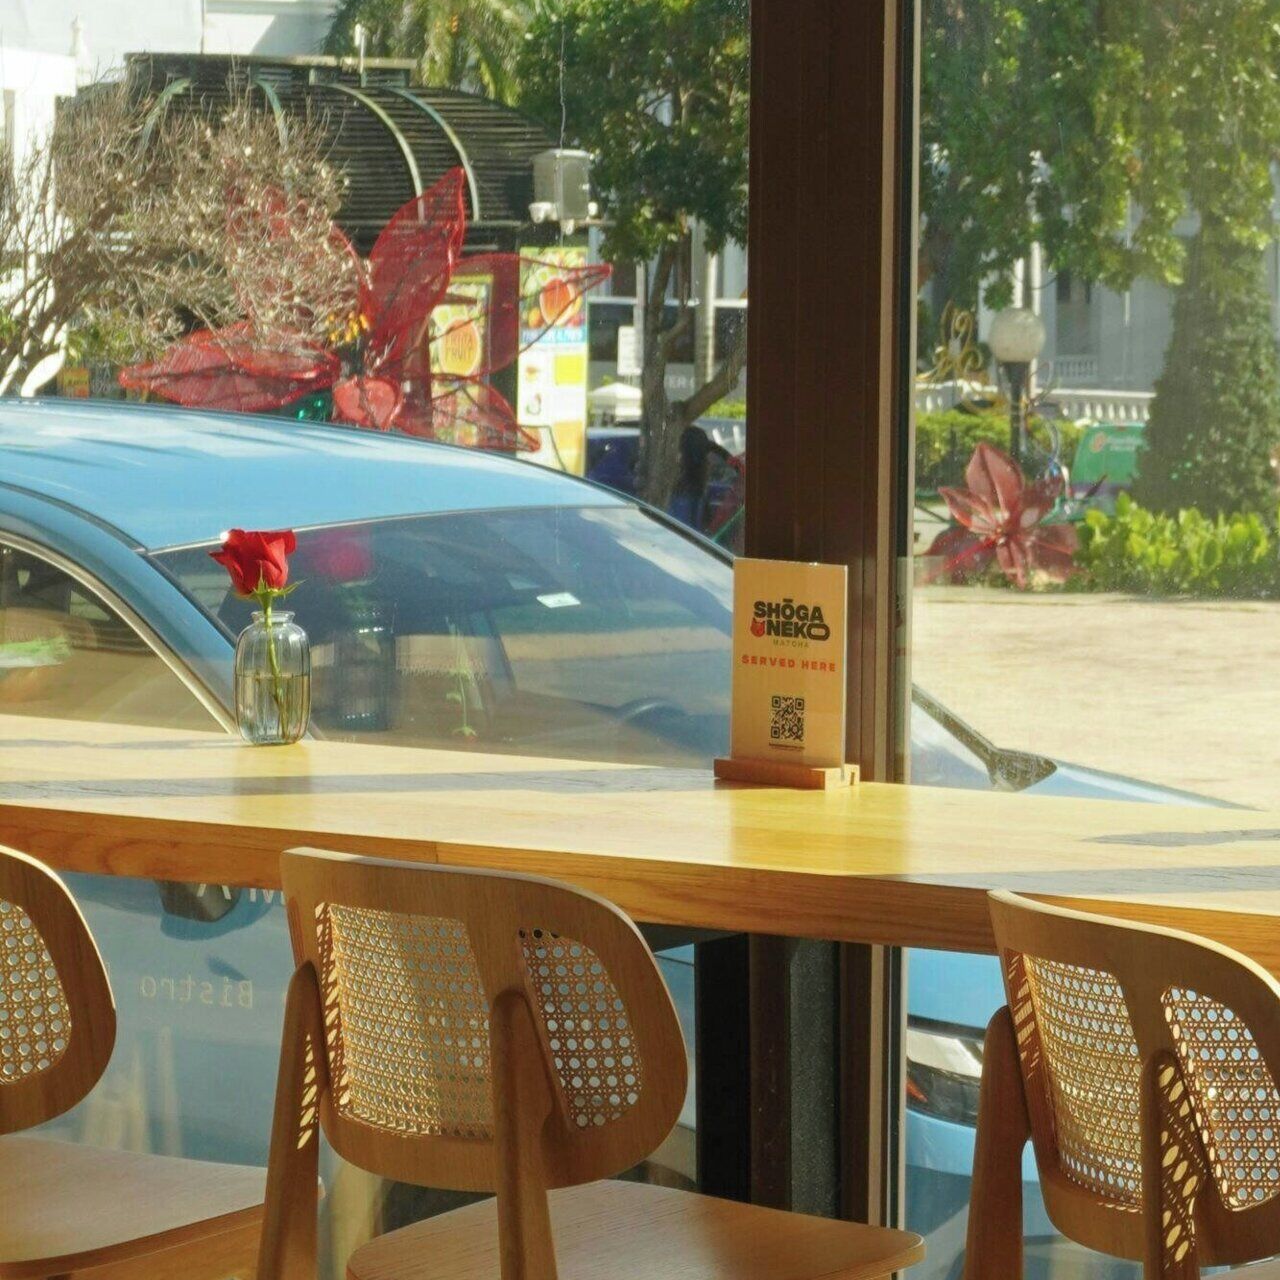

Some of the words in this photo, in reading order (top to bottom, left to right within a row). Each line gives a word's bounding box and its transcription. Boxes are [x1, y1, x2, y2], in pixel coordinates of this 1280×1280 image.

[765, 619, 831, 641] NEKO
[741, 654, 796, 669] SERVED
[801, 659, 836, 672] HERE
